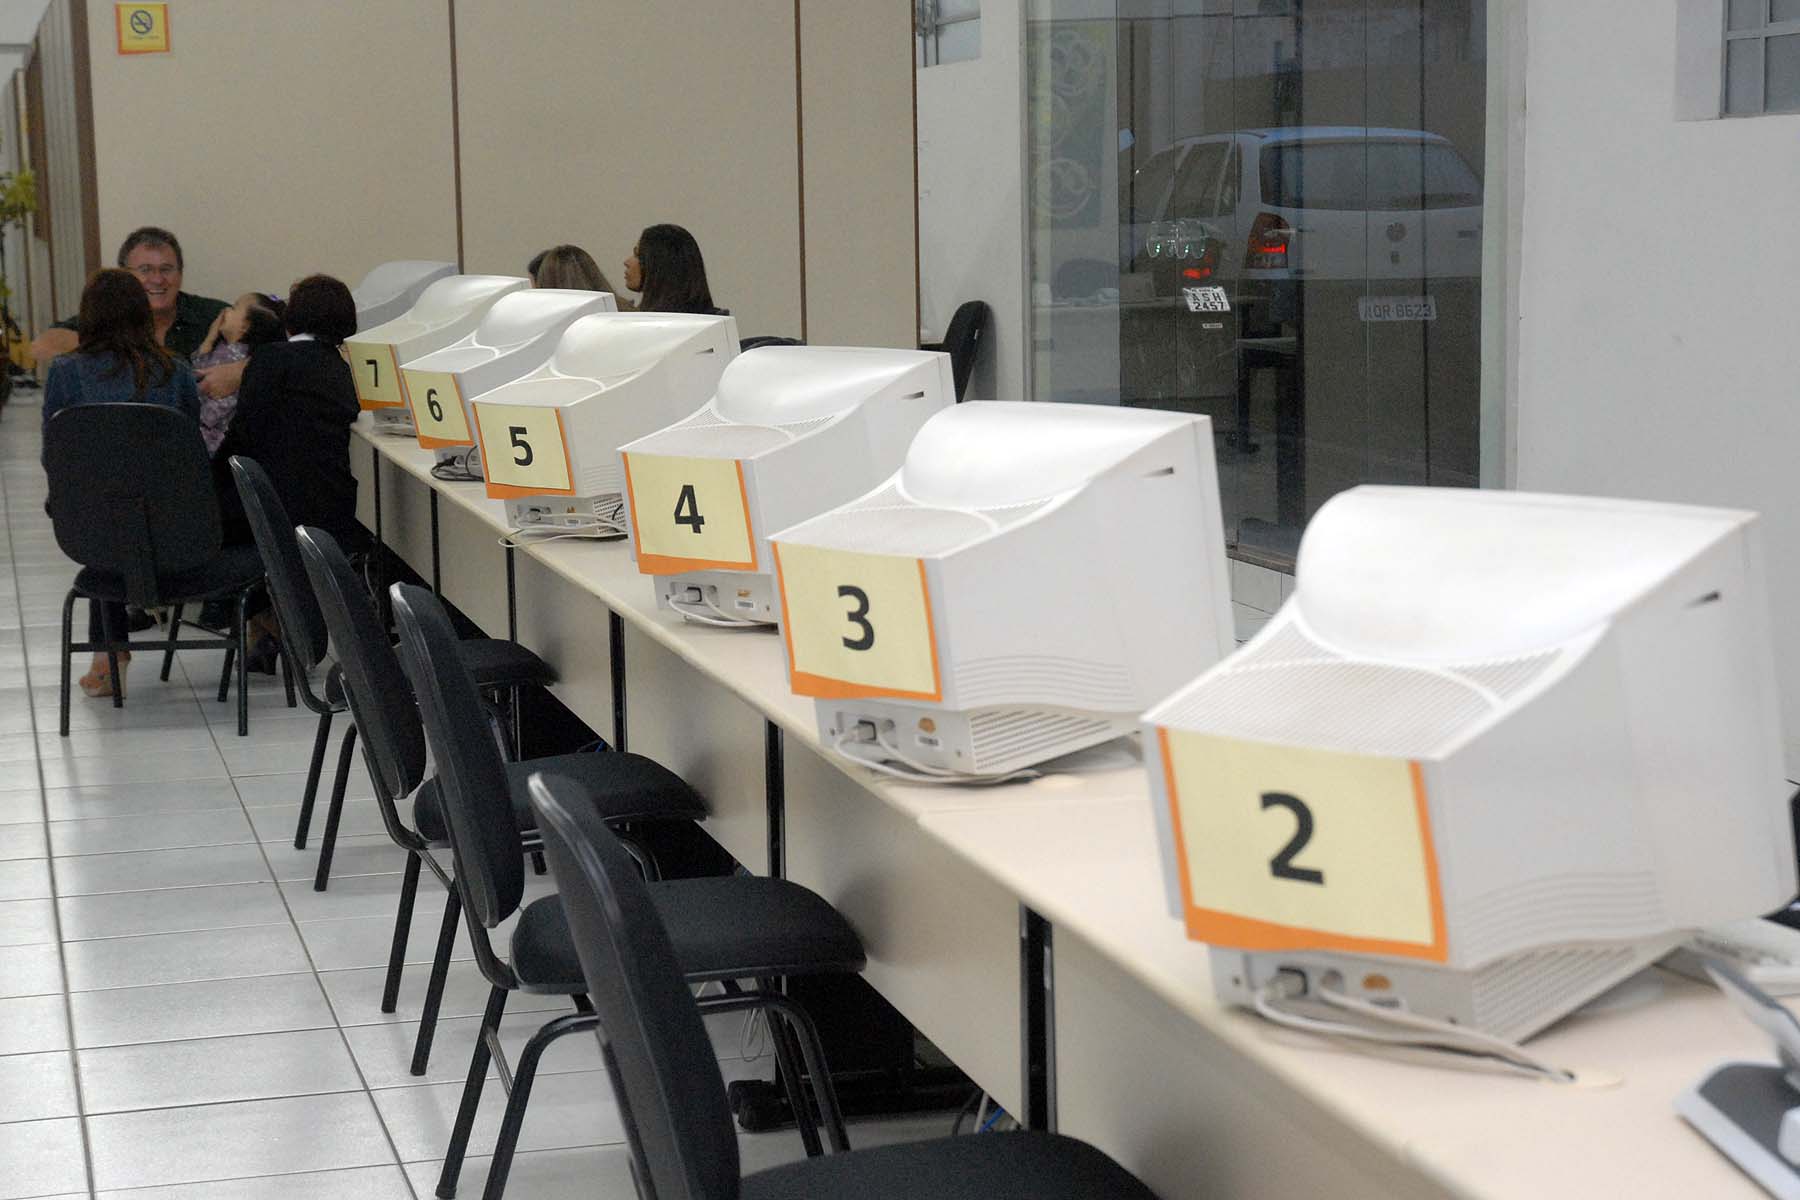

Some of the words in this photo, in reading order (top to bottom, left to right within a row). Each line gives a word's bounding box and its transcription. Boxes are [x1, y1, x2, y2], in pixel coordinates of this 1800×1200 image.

[1192, 301, 1225, 310] 2457
[365, 359, 379, 388] 7
[426, 388, 444, 423] 6
[508, 426, 534, 467] 5
[673, 484, 705, 535] 4
[837, 585, 875, 651] 3
[1260, 791, 1325, 886] 2
